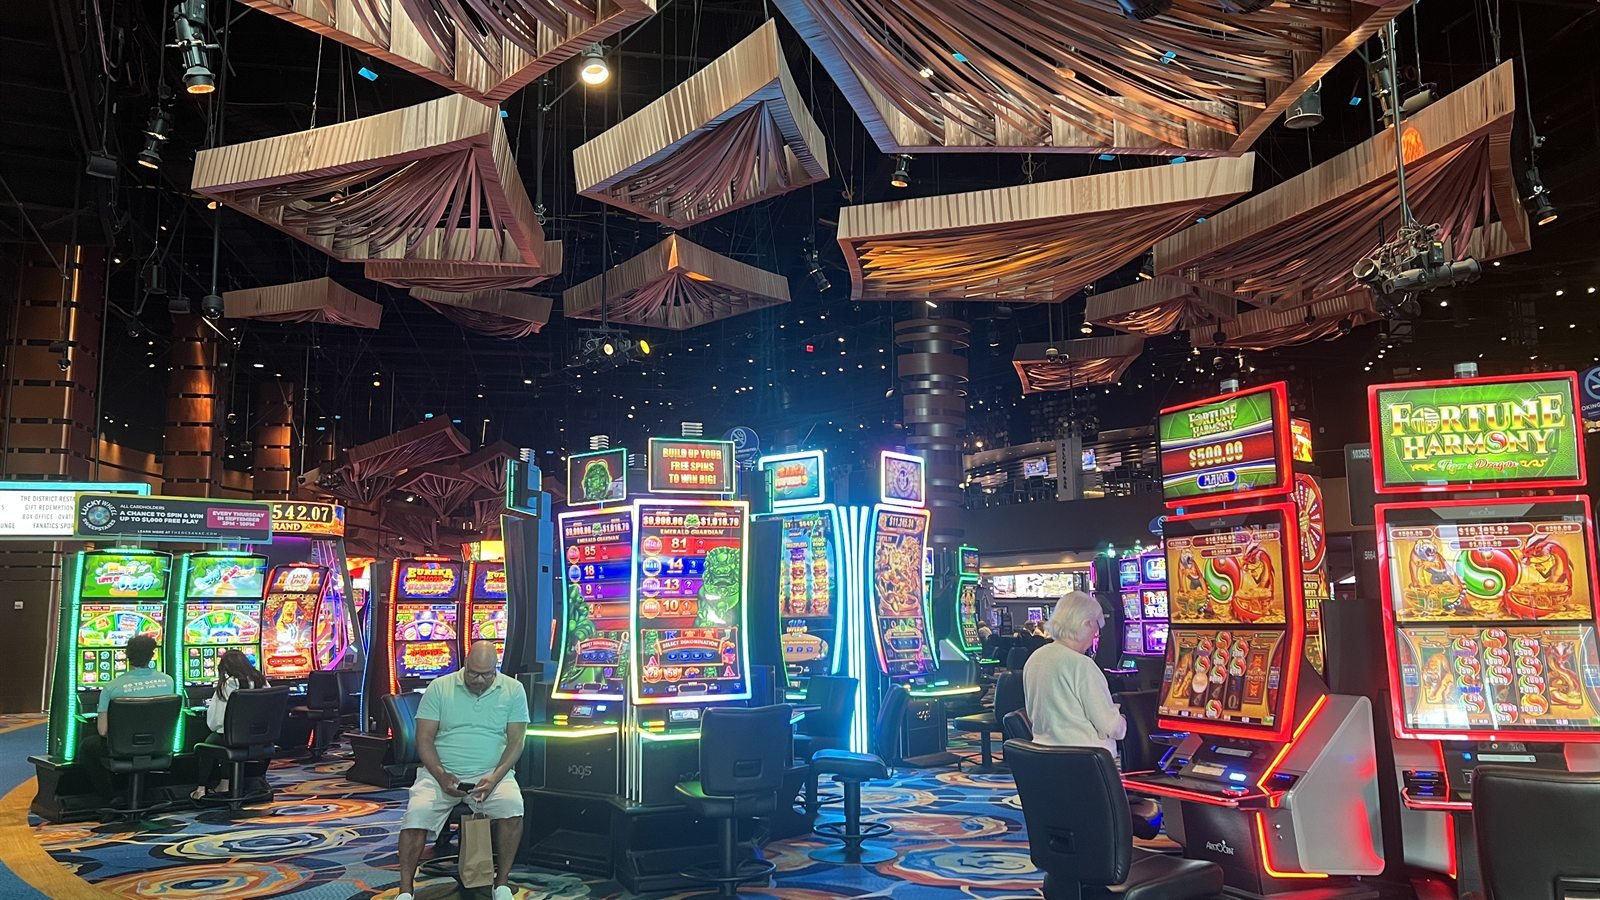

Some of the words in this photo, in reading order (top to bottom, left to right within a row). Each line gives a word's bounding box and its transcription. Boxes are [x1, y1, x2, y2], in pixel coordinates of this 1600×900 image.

[1188, 403, 1238, 427] FORTUNE
[1390, 394, 1566, 436] FORTUNE
[1192, 419, 1234, 438] HARMONY
[1402, 429, 1553, 461] HARMONY
[662, 448, 687, 458] BUILD
[688, 449, 699, 459] UP
[700, 449, 722, 460] YOUR
[1188, 440, 1243, 468] $500.00
[670, 461, 690, 471] FREE
[690, 462, 714, 472] SPINS
[1437, 460, 1467, 475] Tiger
[1474, 459, 1518, 473] Dragon
[668, 474, 680, 484] TO
[680, 474, 698, 484] WIN
[699, 475, 717, 485] BIG!
[1203, 471, 1229, 488] MAJOR
[81, 499, 102, 516] LUCKY
[101, 500, 118, 516] WHEEL
[271, 504, 330, 522] 542.07
[82, 517, 117, 532] SWEEPSTAKES
[271, 522, 301, 531] RAND
[671, 537, 687, 550] 81
[584, 545, 596, 556] 85
[668, 558, 683, 570] 14
[407, 567, 454, 579] EUREKA
[583, 565, 595, 576] 18
[585, 584, 592, 594] 9
[664, 579, 680, 590] 13
[663, 600, 679, 611] 10
[662, 641, 680, 649] SELECT
[680, 639, 719, 647] DENOMINATION
